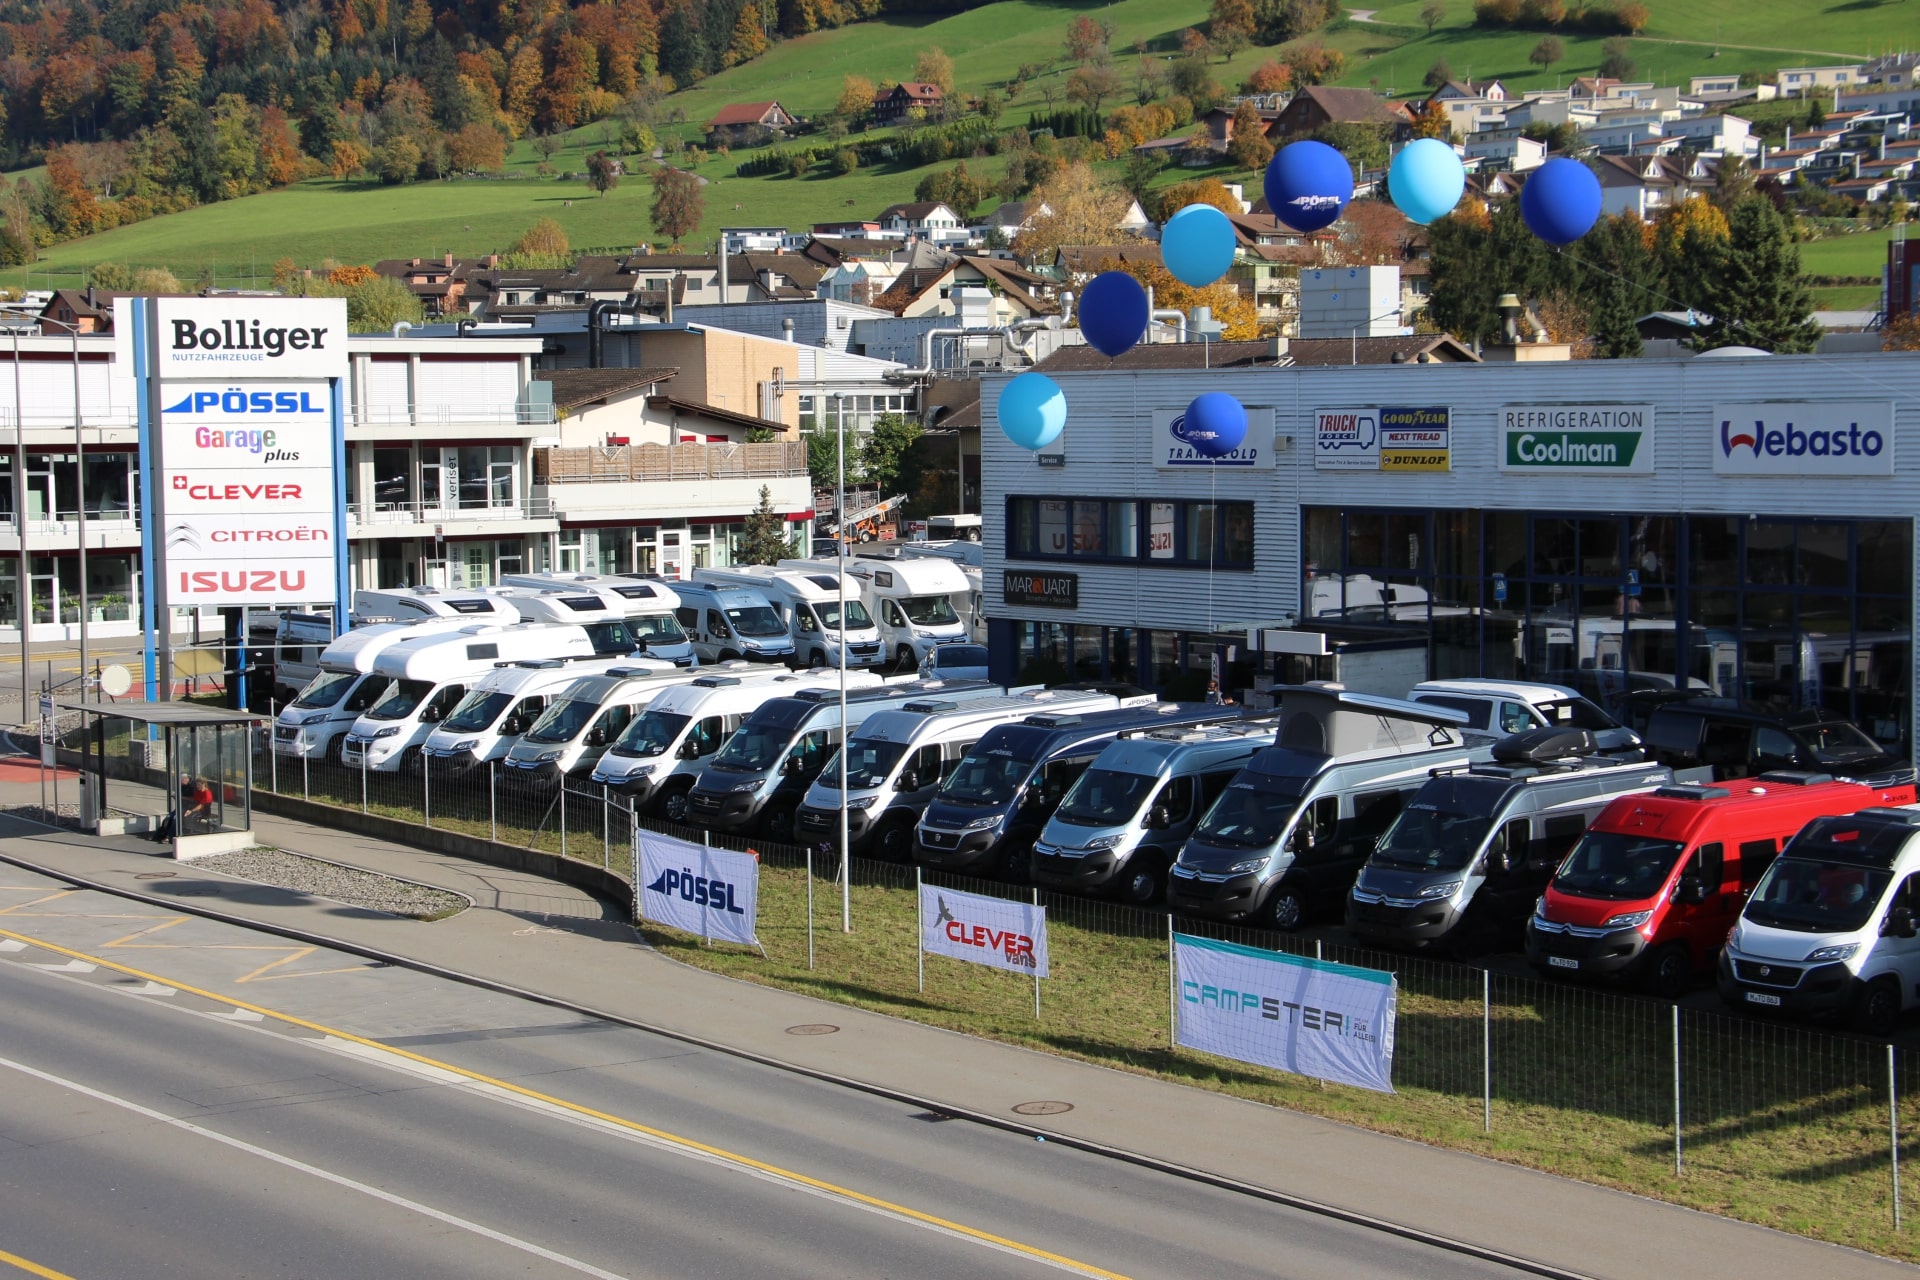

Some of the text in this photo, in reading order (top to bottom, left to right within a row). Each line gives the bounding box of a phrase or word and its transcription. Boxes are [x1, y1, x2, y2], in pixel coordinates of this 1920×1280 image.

[171, 319, 328, 357] Bolliger
[194, 388, 325, 413] PÖSSL
[1319, 414, 1357, 432] TRUCK
[1382, 412, 1446, 425] GOODYEAR
[1506, 411, 1643, 428] REFRIGERATION
[195, 426, 276, 454] Garage
[1388, 433, 1440, 441] NEXT TREAD
[1721, 420, 1884, 459] Webasto
[264, 449, 300, 464] plus
[1516, 433, 1617, 463] Coolman
[1393, 456, 1446, 465] DUNLOP
[446, 456, 457, 500] veriset
[188, 484, 303, 500] CLEVER
[210, 526, 329, 541] CITROËN
[180, 570, 306, 593] ISUZU
[665, 867, 744, 914] PÖSSL
[946, 921, 1034, 960] CLEVER
[1004, 951, 1037, 968] vans
[1354, 1022, 1366, 1032] FÜR
